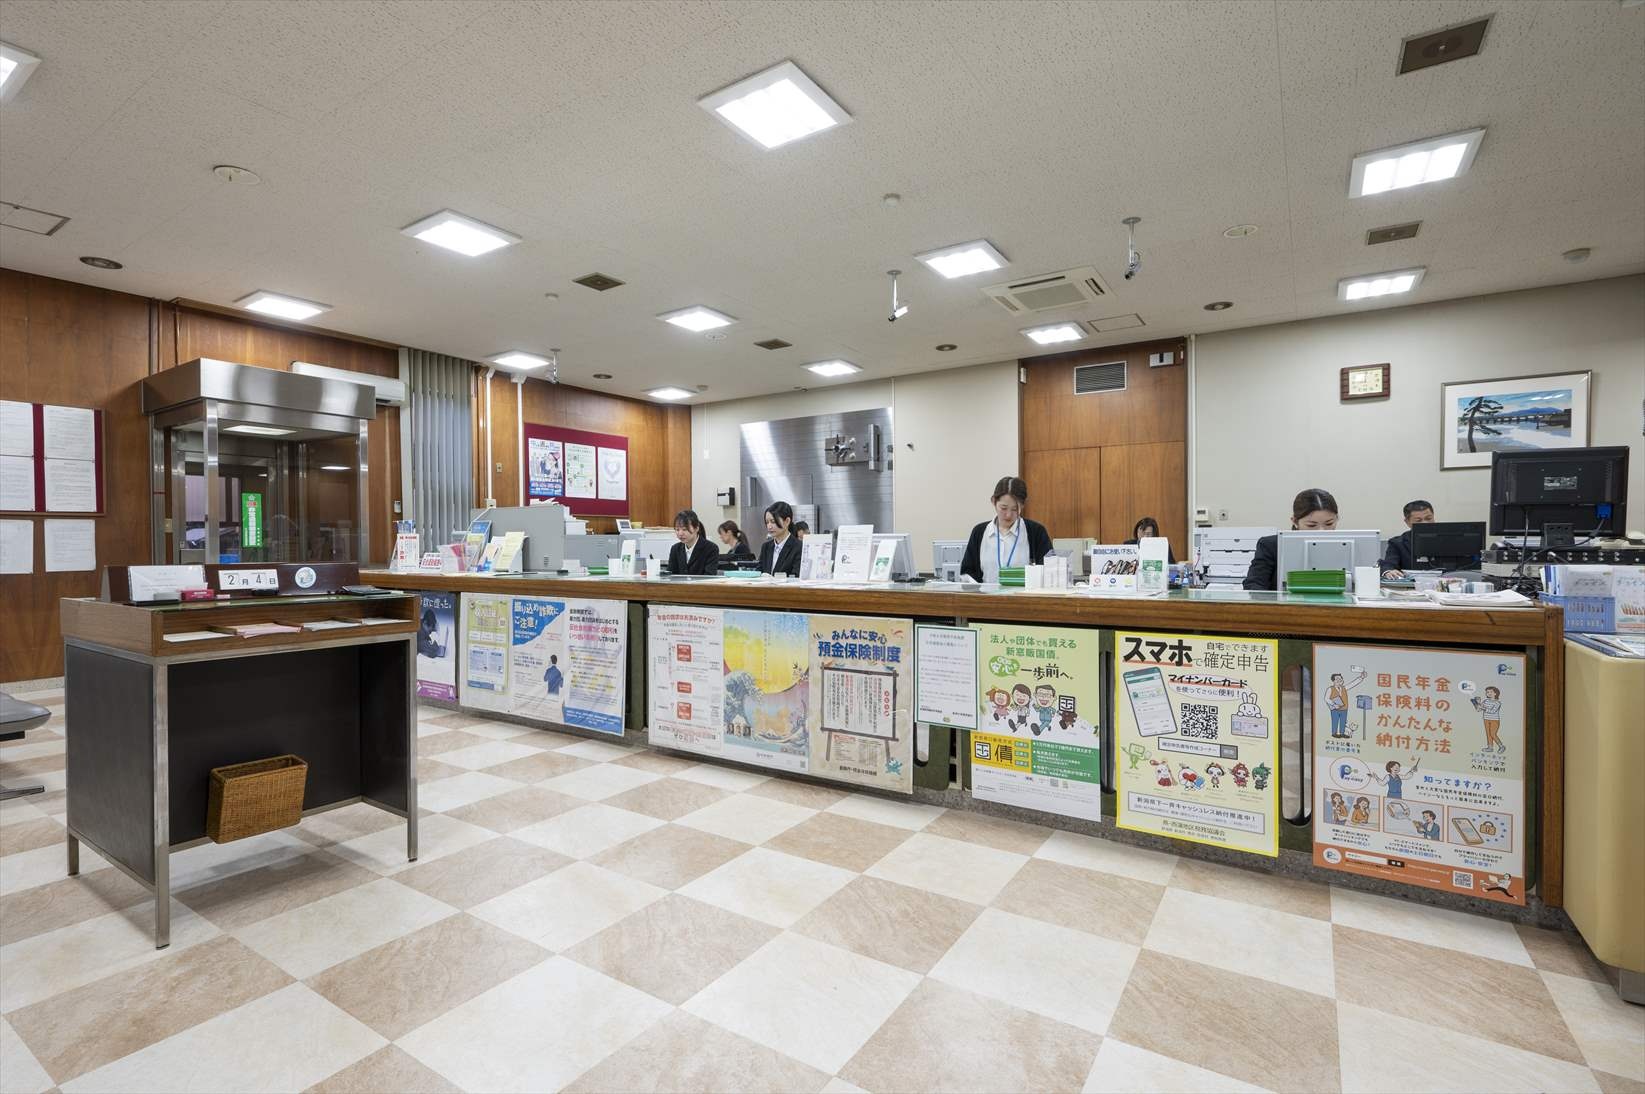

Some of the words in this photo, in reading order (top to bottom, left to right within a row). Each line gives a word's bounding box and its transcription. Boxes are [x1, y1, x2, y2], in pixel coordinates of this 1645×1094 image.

[831, 628, 888, 645] みんなに安心
[990, 634, 1077, 649] 法人や団体でも買える
[817, 641, 902, 664] 預金保険制度
[1123, 637, 1193, 667] スマホ
[1206, 641, 1269, 654] 自宅でできます
[1020, 663, 1074, 681] 一歩前へ。
[1168, 674, 1248, 688] マイナンバーカード
[1376, 673, 1451, 693] 国民年金
[1376, 693, 1450, 712] 保険料の
[1376, 713, 1453, 733] かんたんな
[1376, 732, 1452, 754] 納付方法
[1423, 775, 1493, 791] 知ってますか？
